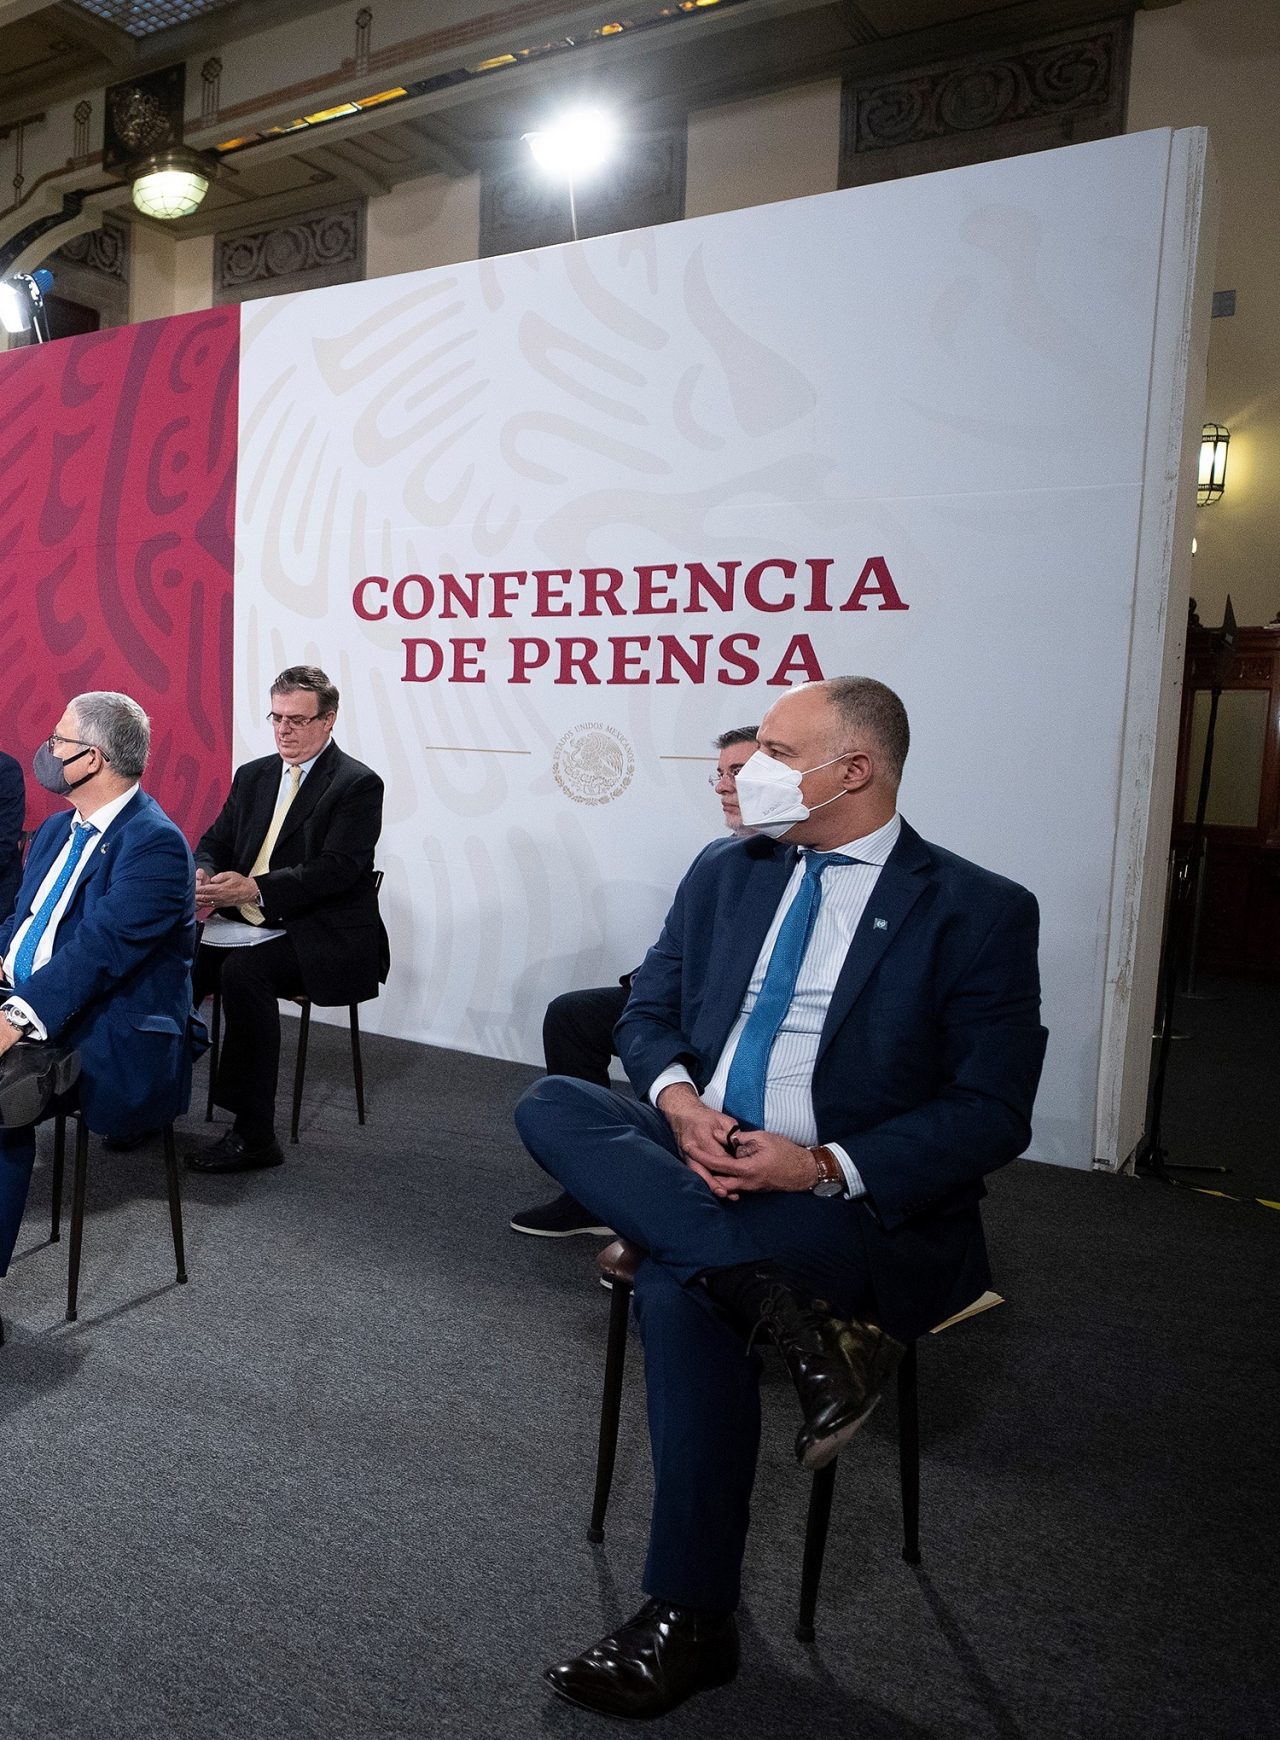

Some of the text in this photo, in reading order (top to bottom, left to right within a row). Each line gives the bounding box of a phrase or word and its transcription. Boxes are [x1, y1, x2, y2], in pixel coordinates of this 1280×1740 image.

[352, 556, 910, 621] CONFERENCIA
[401, 633, 825, 686] DE PRENSA
[553, 722, 635, 763] ESTADOS UNIDOS MEXICANOS
